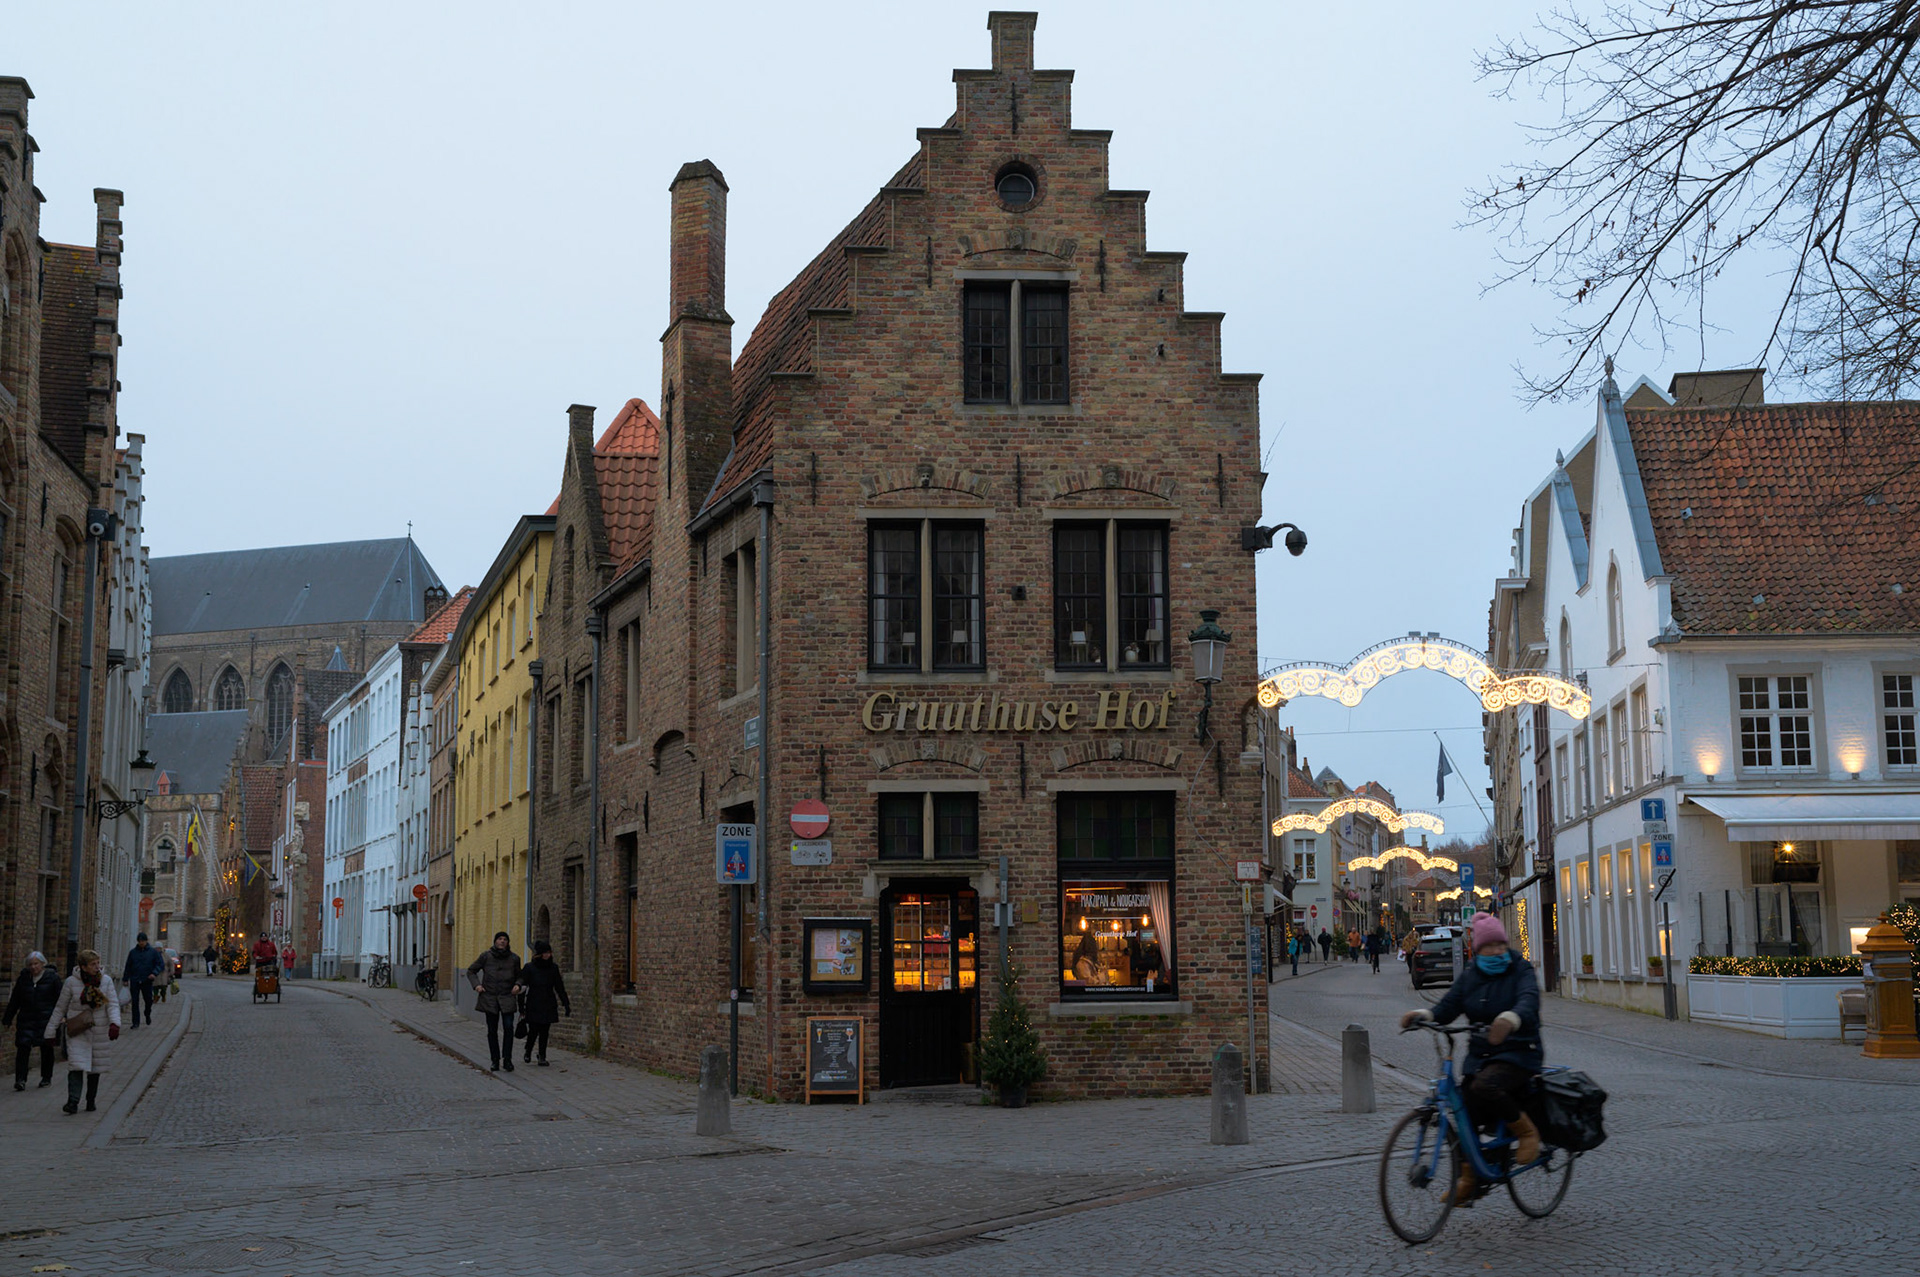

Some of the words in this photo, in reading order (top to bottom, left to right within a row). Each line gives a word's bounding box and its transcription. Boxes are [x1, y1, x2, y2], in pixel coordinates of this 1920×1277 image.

[861, 691, 1078, 732] Gruuthuse
[1094, 689, 1177, 731] Hof
[722, 826, 752, 836] ZONE
[1461, 866, 1472, 881] P
[1080, 894, 1109, 908] MARZIPAN
[1110, 897, 1116, 908] &
[1117, 894, 1151, 907] NOUGATSHOP
